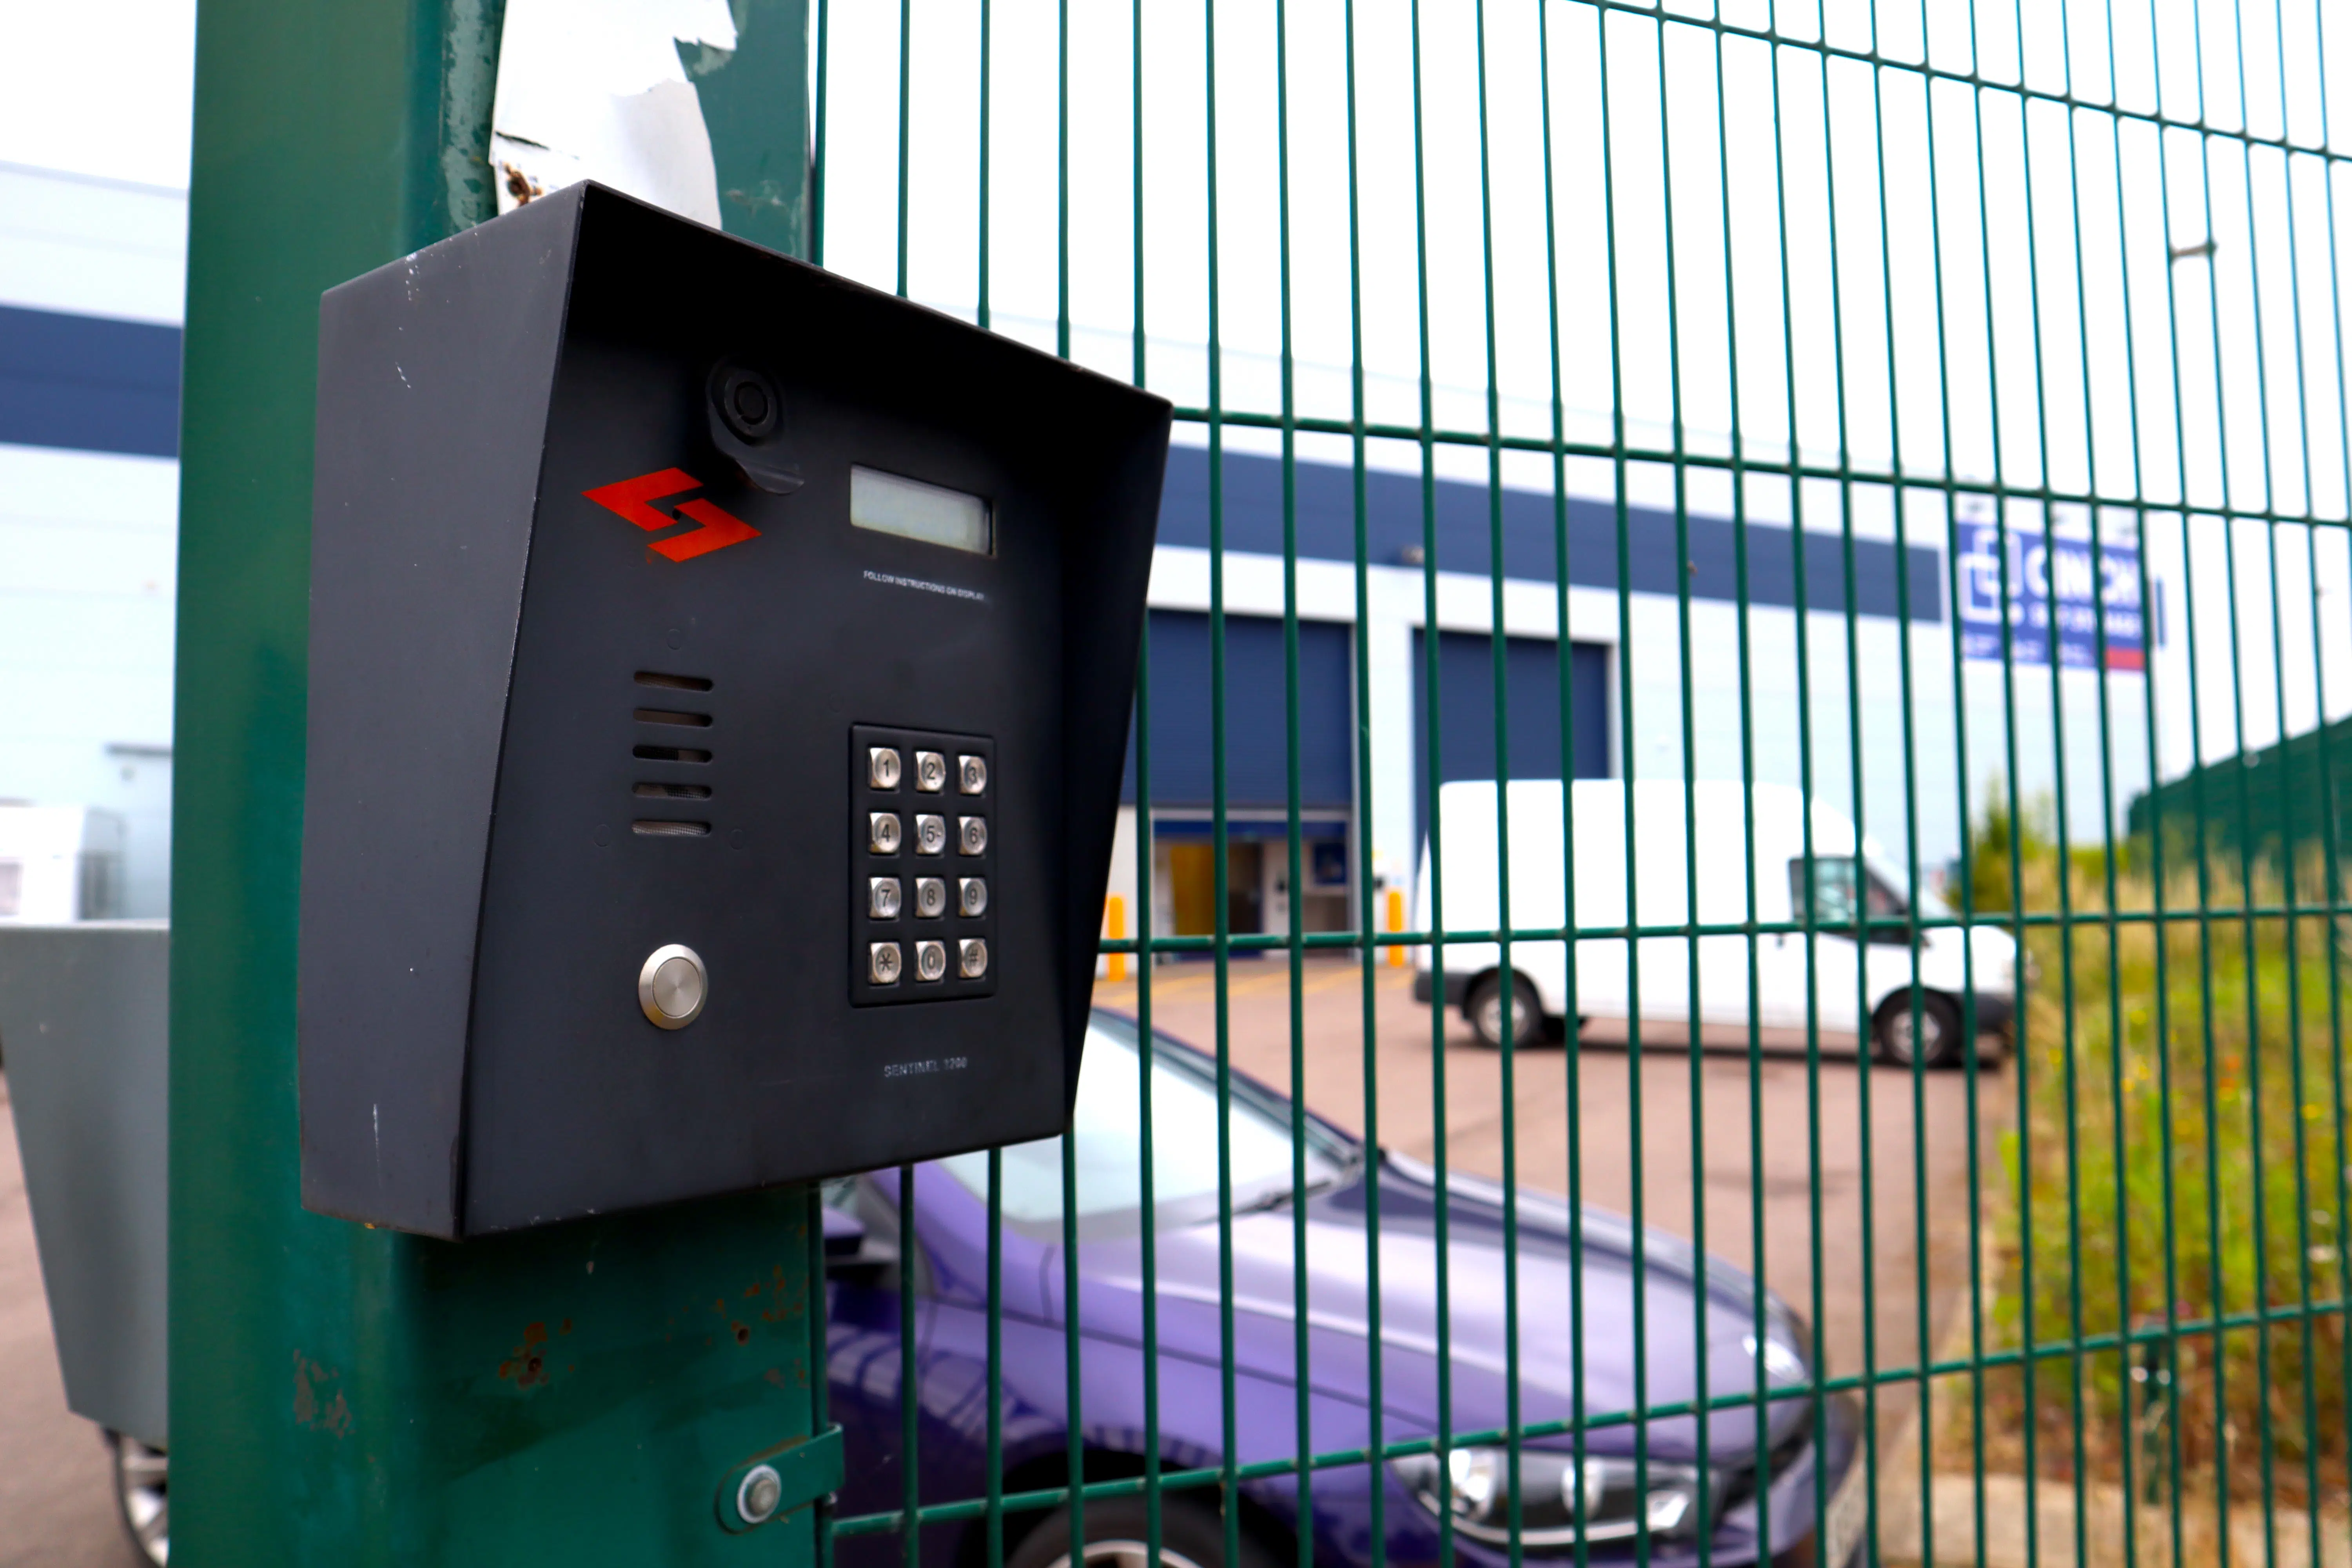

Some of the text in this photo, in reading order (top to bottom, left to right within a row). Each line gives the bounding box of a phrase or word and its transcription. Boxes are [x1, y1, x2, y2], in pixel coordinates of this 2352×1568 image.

[863, 570, 894, 583] FOLLOW
[895, 577, 945, 593] INSTRUCTIONS
[946, 586, 956, 595] ON
[883, 759, 977, 784] 1 2 3
[881, 824, 978, 844] 4 5 6
[882, 888, 977, 907] 7 8 9
[927, 952, 935, 970] 0
[884, 1060, 940, 1078] SENTINEL
